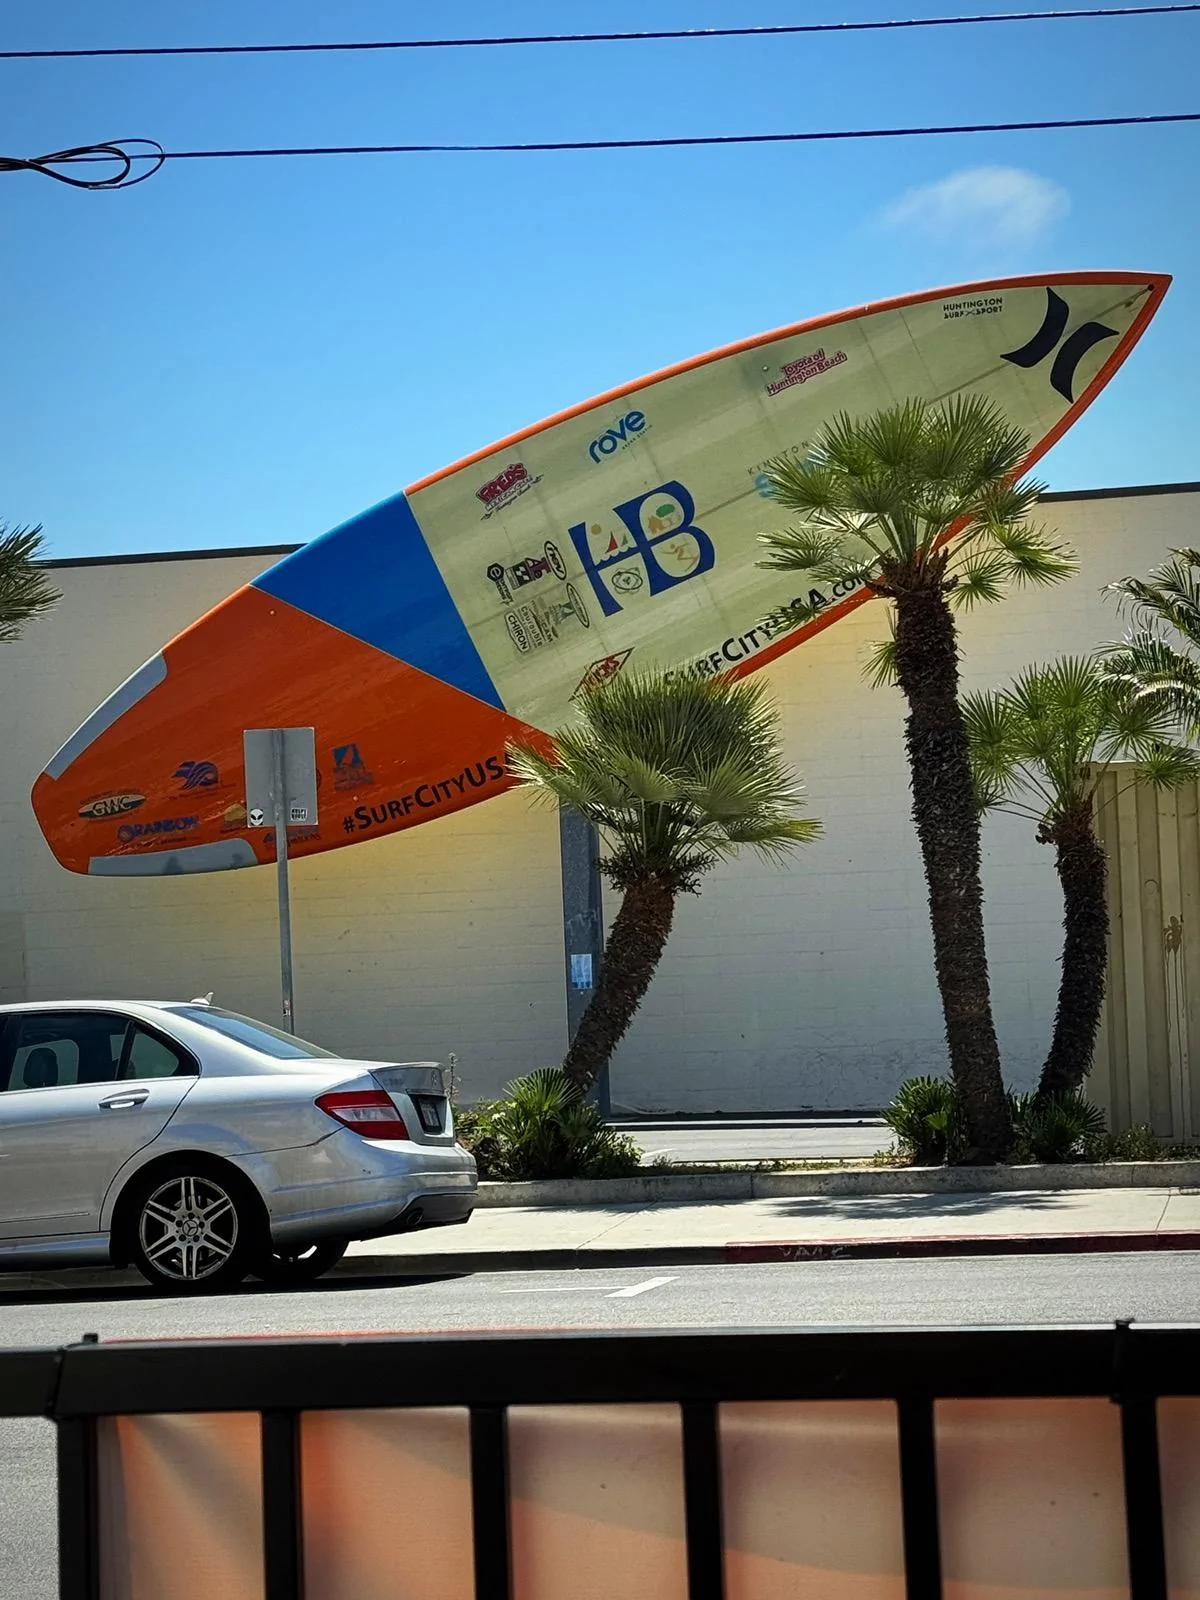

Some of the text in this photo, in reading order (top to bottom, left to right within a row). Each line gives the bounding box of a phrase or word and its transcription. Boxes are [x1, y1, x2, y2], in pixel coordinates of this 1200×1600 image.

[943, 297, 1003, 312] HUNTINGTON
[943, 306, 1003, 319] SURF SPORT
[766, 351, 847, 395] Huntington Beach
[781, 348, 825, 375] Toyota of
[589, 411, 646, 464] rove
[567, 480, 716, 617] HB
[507, 614, 529, 650] CHIRON
[91, 795, 132, 817] GWC
